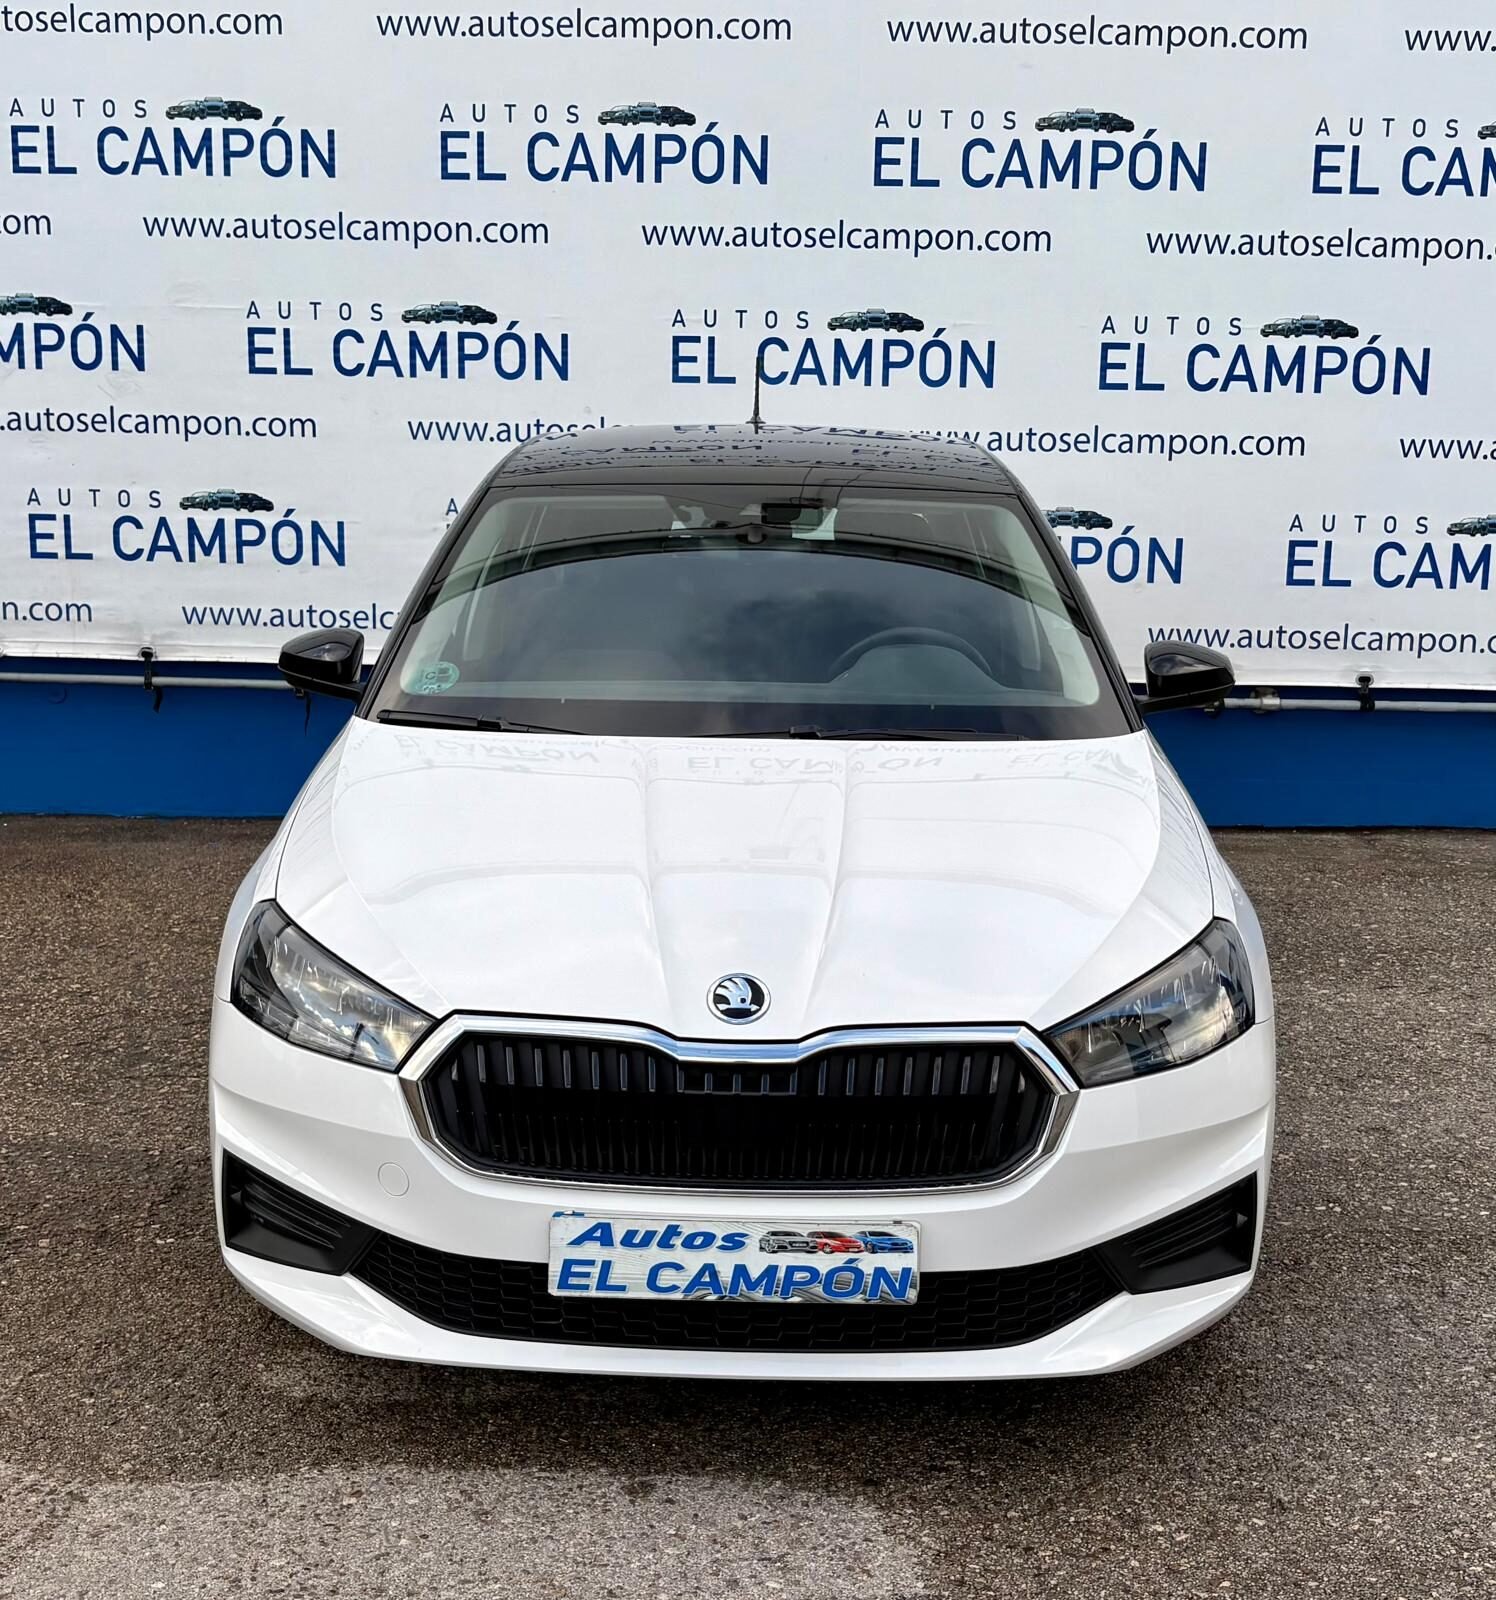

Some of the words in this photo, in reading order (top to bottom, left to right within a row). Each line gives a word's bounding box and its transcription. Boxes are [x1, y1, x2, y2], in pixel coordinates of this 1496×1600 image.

[0, 3, 282, 41] toselcampon.com
[376, 8, 791, 46] www.autoselcampon.com
[887, 15, 1307, 54] www.autoselcampon.com
[10, 98, 147, 118] AUTOS
[440, 104, 579, 123] AUTOS
[875, 109, 1016, 130] AUTOS
[1315, 117, 1458, 138] AUTOS
[11, 125, 77, 174] EL
[97, 117, 336, 178] CAMPÓN
[441, 131, 506, 181] EL
[527, 122, 768, 185] CAMPÓN
[874, 137, 940, 187] EL
[962, 129, 1207, 191] CAMPÓN
[1312, 144, 1379, 195] EL
[143, 212, 548, 249] www.autoselcampon.com
[642, 220, 1051, 258] www.autoselcampon.com
[1147, 228, 1496, 266] www.autoselcampon.
[247, 301, 383, 321] AUTOS
[672, 309, 808, 329] AUTOS
[1101, 315, 1241, 336] AUTOS
[247, 327, 313, 375] EL
[333, 322, 568, 381] CAMPÓN
[672, 336, 736, 384] EL
[757, 329, 996, 388] CAMPÓN
[1099, 342, 1165, 391] EL
[1187, 335, 1430, 395] CAMPÓN
[27, 488, 161, 508] AUTOS
[28, 513, 93, 560] EL
[113, 510, 345, 566] CAMPÓN
[1289, 514, 1428, 534] AUTOS
[1058, 526, 1184, 584] PÓN
[1286, 540, 1351, 587] EL
[1374, 541, 1491, 590] CAM
[567, 1221, 750, 1253] Autos
[556, 1258, 628, 1293] EL
[645, 1257, 914, 1300] CAMPÓN
